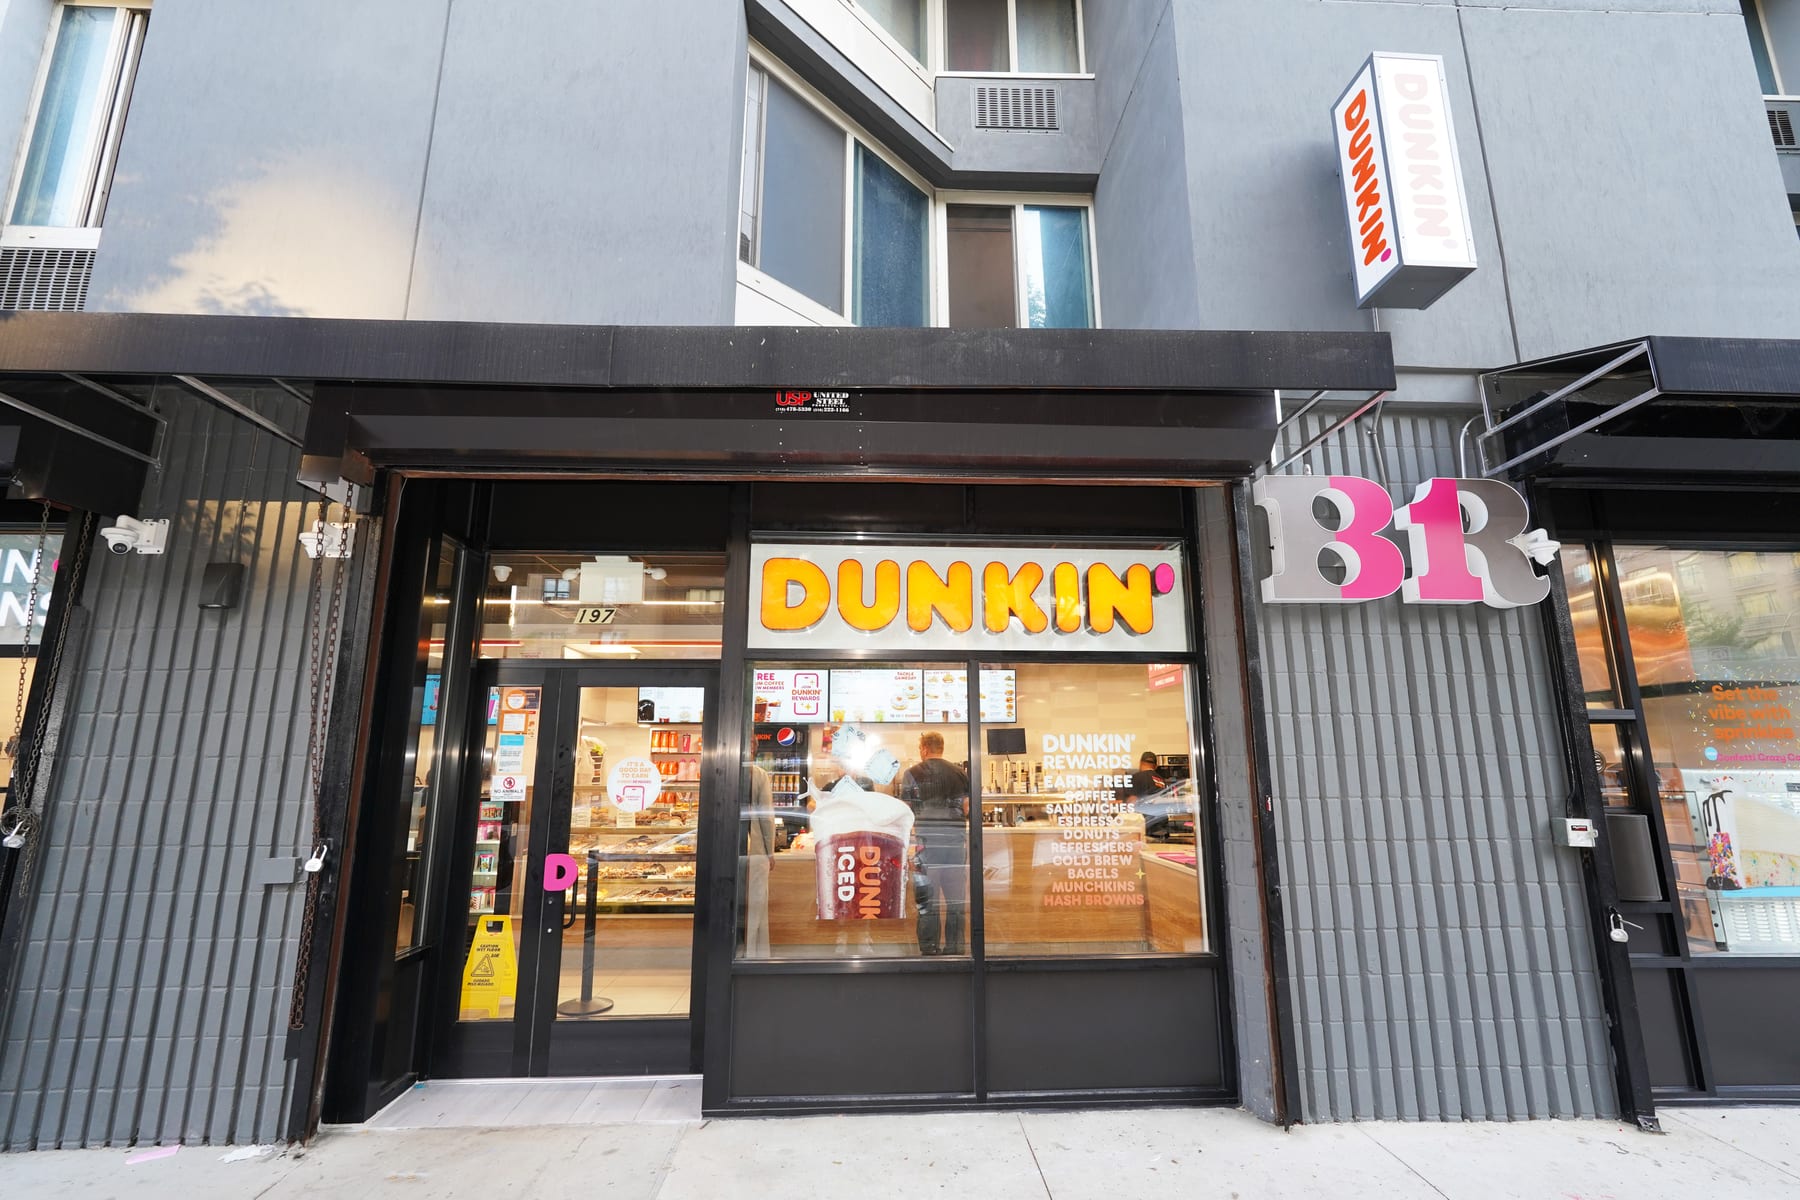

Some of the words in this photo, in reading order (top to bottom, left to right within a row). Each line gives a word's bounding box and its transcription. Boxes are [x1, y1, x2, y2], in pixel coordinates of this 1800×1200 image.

[1344, 89, 1392, 266] DUNKIN'
[776, 391, 812, 406] USP
[760, 557, 1175, 634] DUNKIN'
[578, 609, 615, 623] 197
[1712, 685, 1744, 701] Set
[1747, 685, 1778, 701] the
[1708, 704, 1747, 720] vibe
[1749, 704, 1791, 720] with
[1714, 723, 1795, 744] sprinkles
[1042, 733, 1136, 753] DUNKIN'
[1042, 754, 1132, 769] REWARDS
[1044, 775, 1089, 788] EARN
[1093, 775, 1134, 788] FREE
[1063, 790, 1117, 801] COFFEE
[1046, 803, 1136, 814] SANDWICHES
[1057, 815, 1124, 827] ESPRESSO
[1063, 828, 1120, 840] DONUTS
[1050, 841, 1134, 853] REFRESHERS
[1052, 854, 1091, 866] COLD
[1094, 854, 1133, 866] BREW
[543, 854, 578, 891] D
[837, 846, 855, 902] ICED
[1067, 867, 1119, 879] BAGELS
[1052, 881, 1135, 893] MUNCHKINS
[1044, 894, 1081, 906] HASH
[1085, 893, 1145, 906] BROWNS
